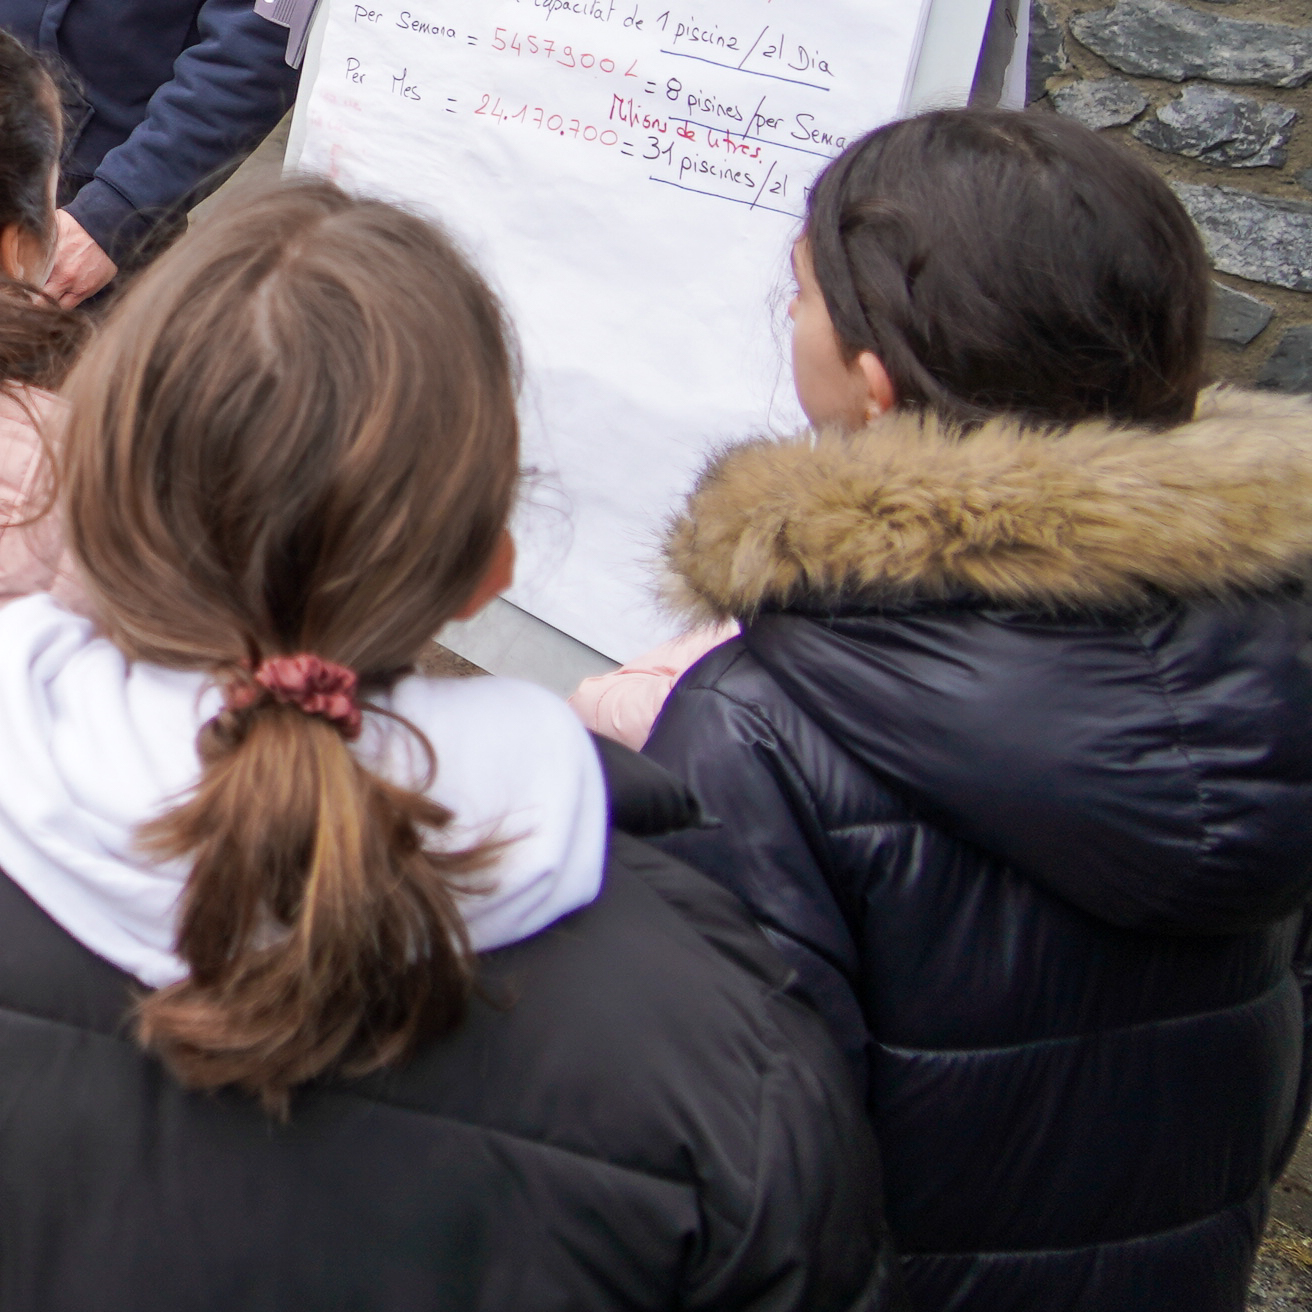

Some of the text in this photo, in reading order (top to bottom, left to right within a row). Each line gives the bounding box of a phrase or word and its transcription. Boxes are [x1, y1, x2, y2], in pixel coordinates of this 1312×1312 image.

[623, 3, 644, 31] de
[656, 10, 670, 31] 1
[787, 45, 835, 77] Dia
[345, 57, 366, 84] Per
[392, 67, 422, 101] Mes
[474, 93, 618, 146] 24.170.700
[624, 59, 638, 78] L
[666, 77, 682, 101] 8
[790, 113, 849, 150] Sema
[676, 120, 696, 142] de
[642, 136, 675, 166] 31
[679, 154, 755, 188] piscines
